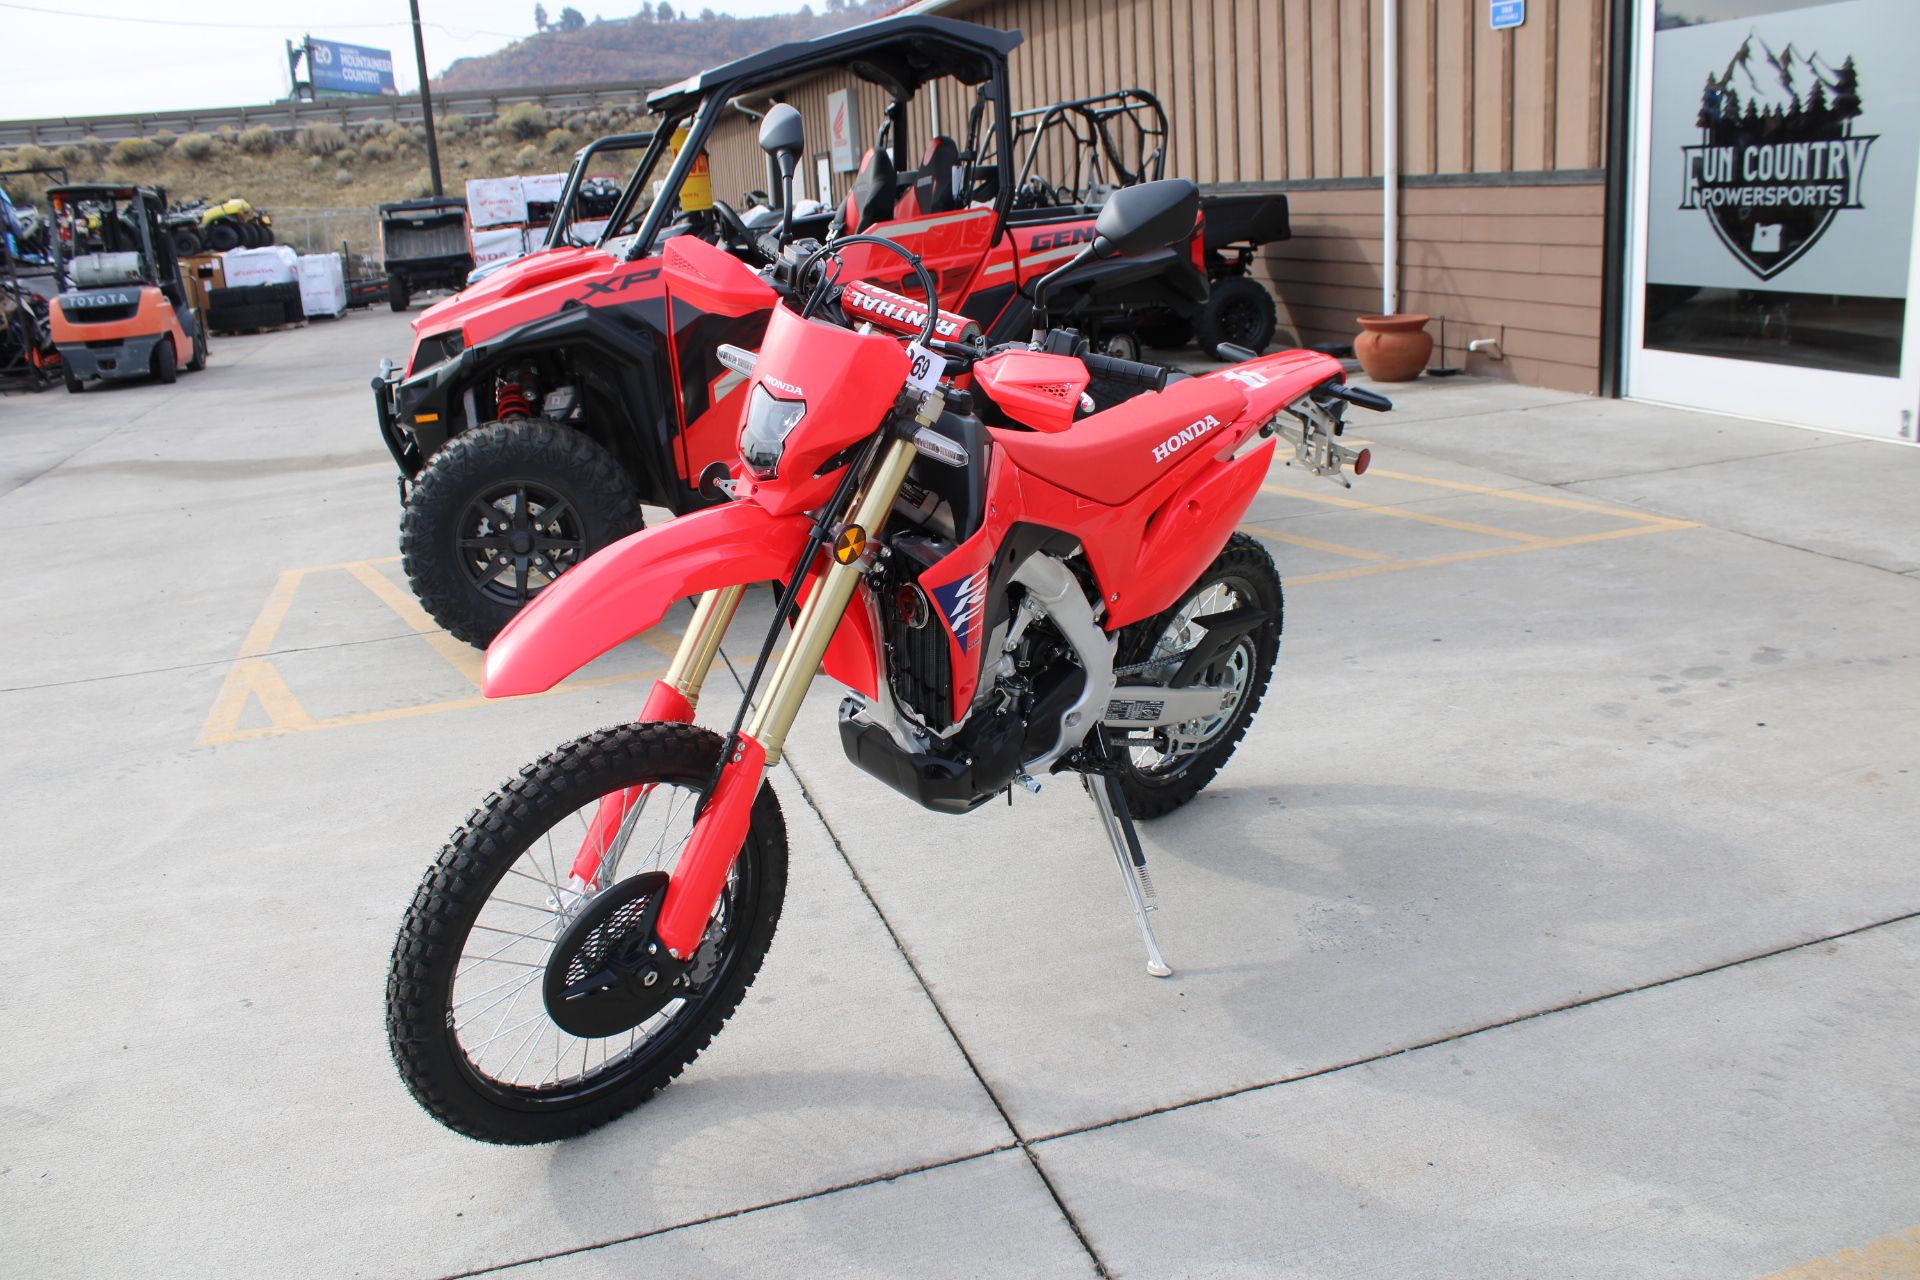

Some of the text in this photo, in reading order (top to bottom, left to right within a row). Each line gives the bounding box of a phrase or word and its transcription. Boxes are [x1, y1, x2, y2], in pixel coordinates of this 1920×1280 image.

[1681, 138, 1873, 208] FUN COUNTRY
[1701, 185, 1843, 207] POWERSPORTS
[578, 267, 663, 301] XP
[69, 293, 129, 308] TOYOTA
[764, 373, 804, 396] HONDA
[1152, 414, 1221, 463] HONDA
